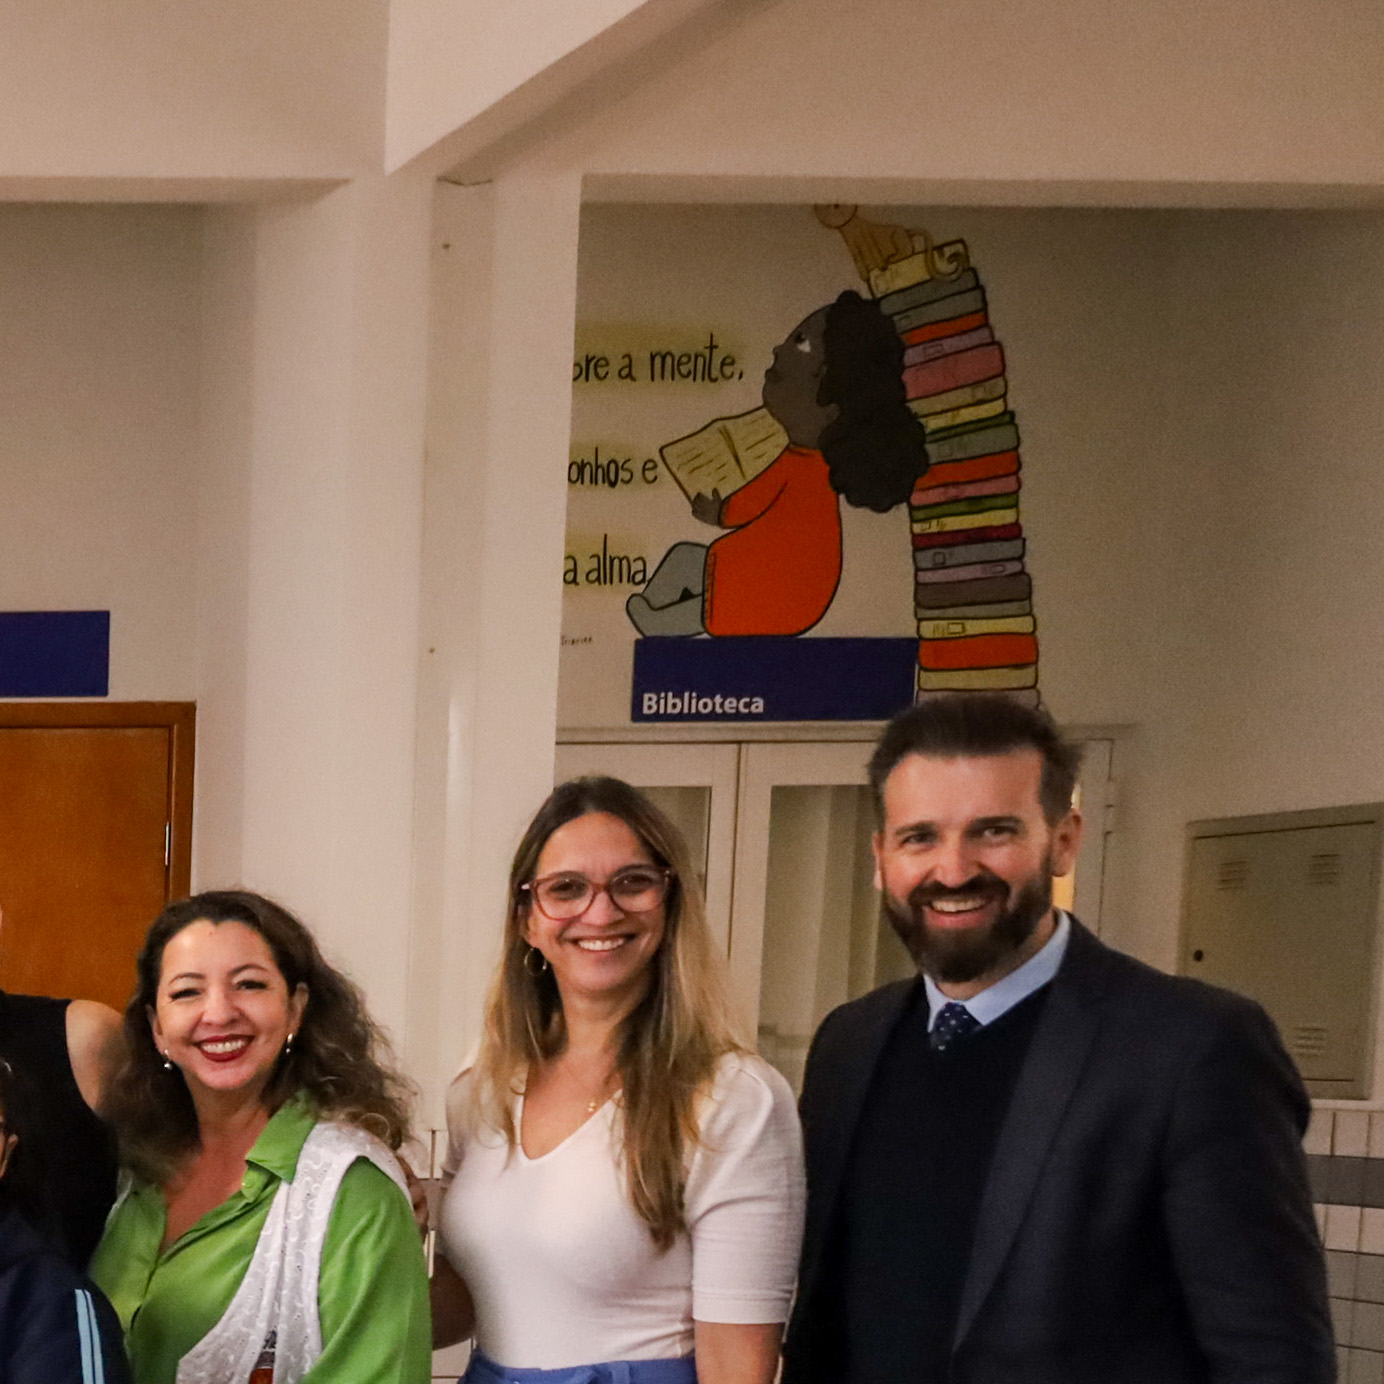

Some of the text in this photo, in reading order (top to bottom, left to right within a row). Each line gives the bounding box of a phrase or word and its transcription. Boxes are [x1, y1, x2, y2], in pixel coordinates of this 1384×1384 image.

[618, 353, 636, 382] a
[642, 458, 658, 485] e
[642, 691, 764, 715] Biblioteca
